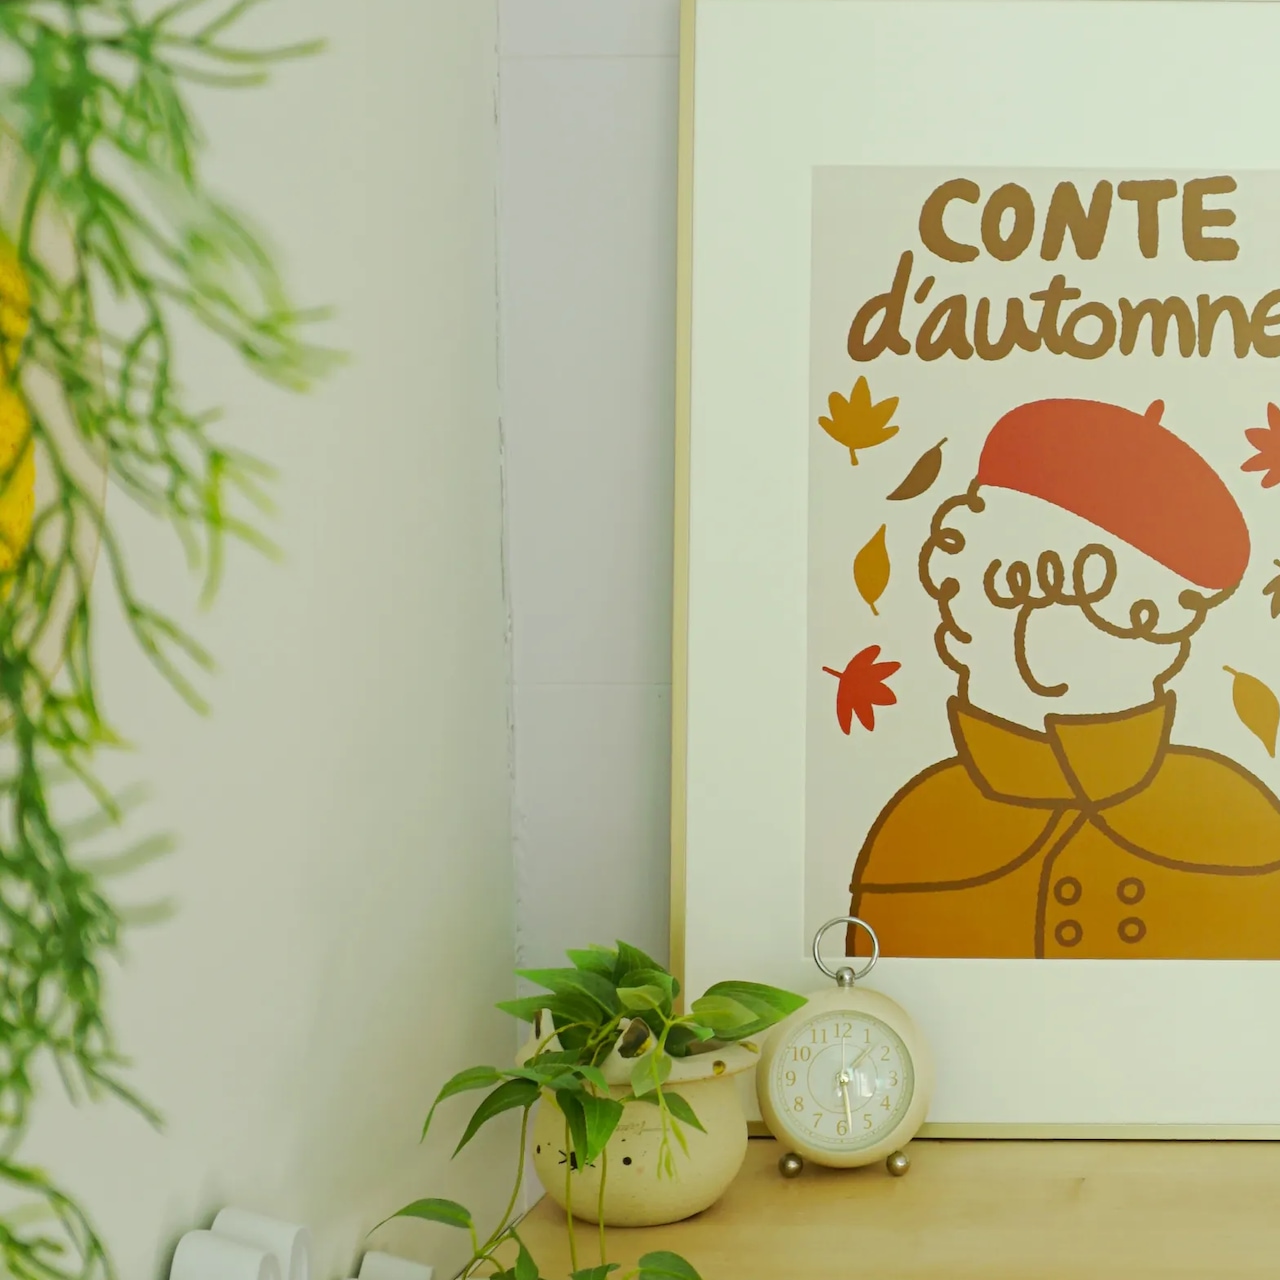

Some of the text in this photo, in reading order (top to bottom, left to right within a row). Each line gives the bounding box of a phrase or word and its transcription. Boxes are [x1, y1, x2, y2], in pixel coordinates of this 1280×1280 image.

[918, 175, 1240, 263] CONTE
[811, 1028, 828, 1044] 11
[834, 1022, 852, 1038] 12
[864, 1028, 870, 1044] 1
[792, 1046, 811, 1062] 10
[880, 1046, 890, 1061] 2
[785, 1070, 796, 1086] 9
[888, 1070, 898, 1087] 3
[793, 1096, 804, 1112] 8
[880, 1095, 891, 1110] 4
[813, 1113, 823, 1128] 7
[836, 1121, 848, 1136] 6
[863, 1114, 872, 1129] 5
